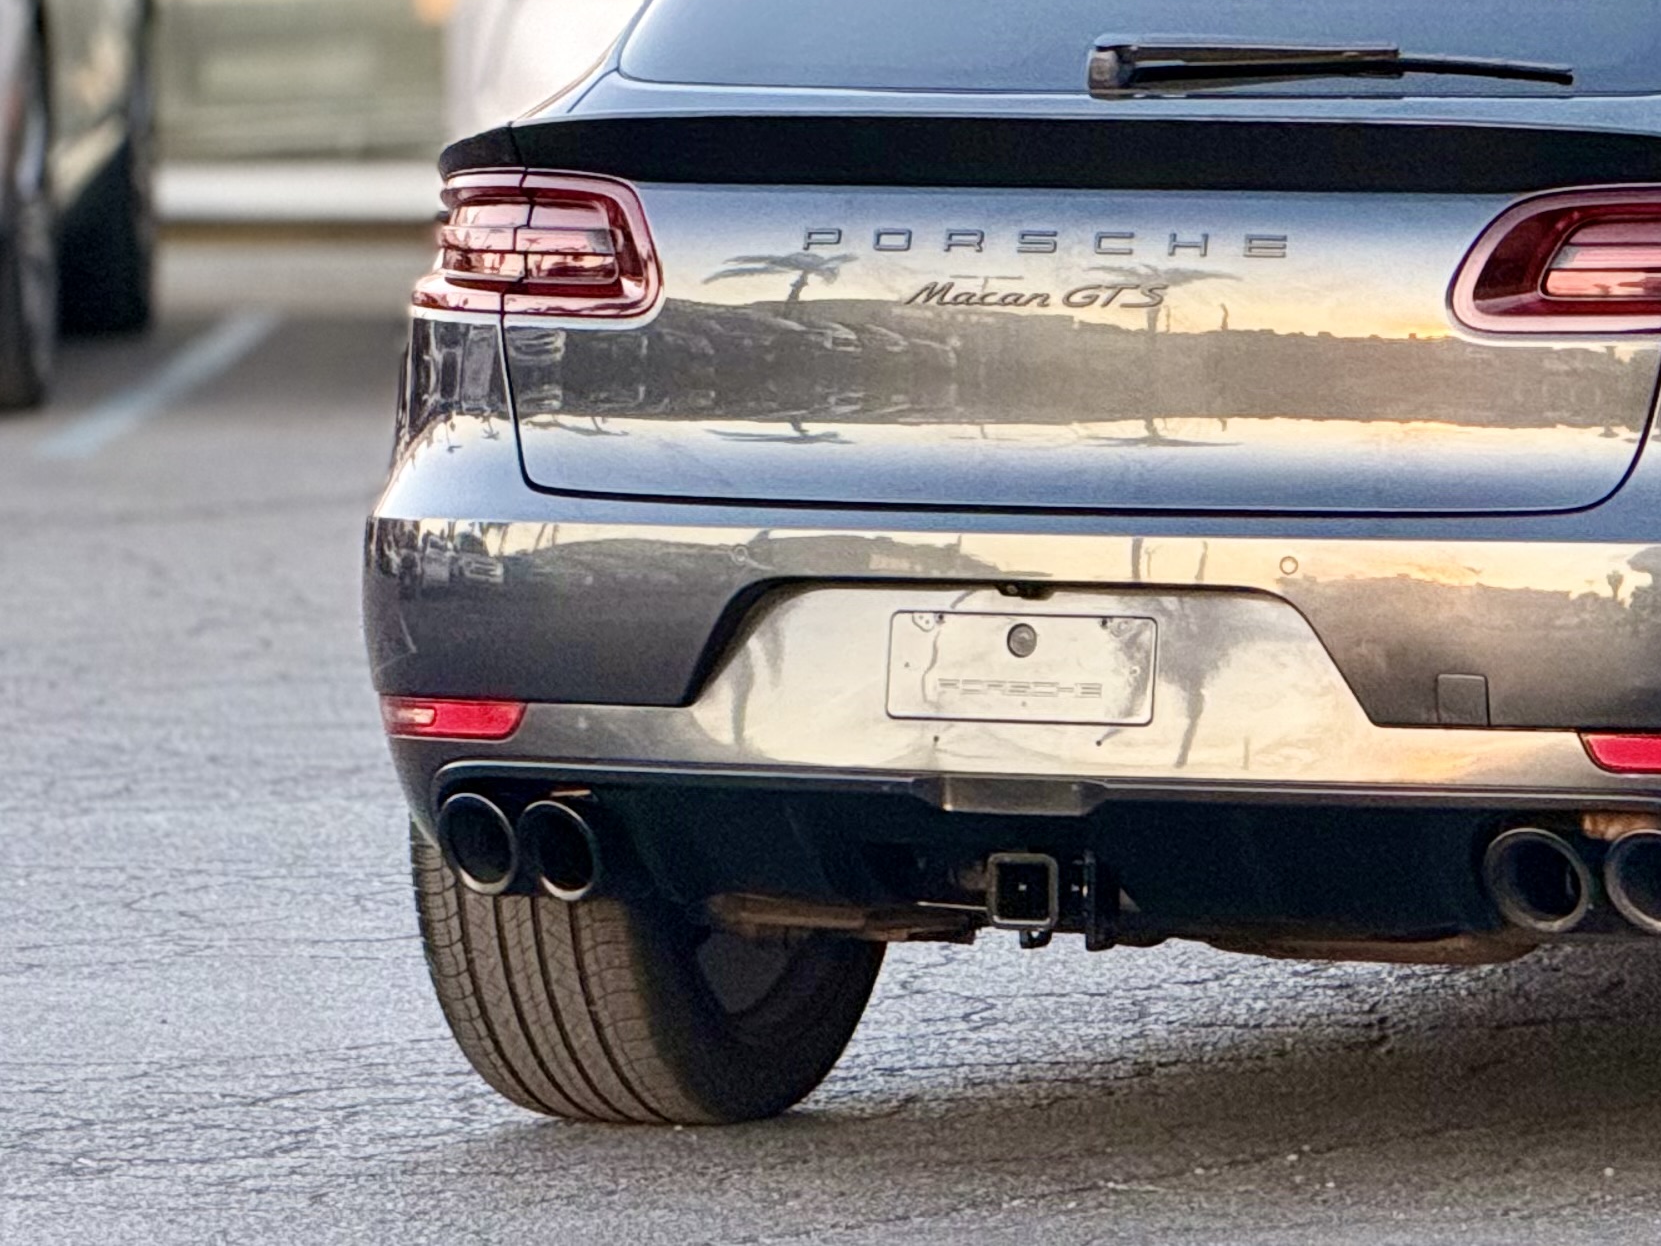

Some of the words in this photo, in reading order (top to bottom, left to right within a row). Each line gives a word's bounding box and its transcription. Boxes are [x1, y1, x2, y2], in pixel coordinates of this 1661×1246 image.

[803, 227, 1288, 258] PORSCHE
[904, 281, 1051, 308] Macan
[1061, 283, 1169, 308] GTS
[936, 677, 1103, 699] PORSCHE
